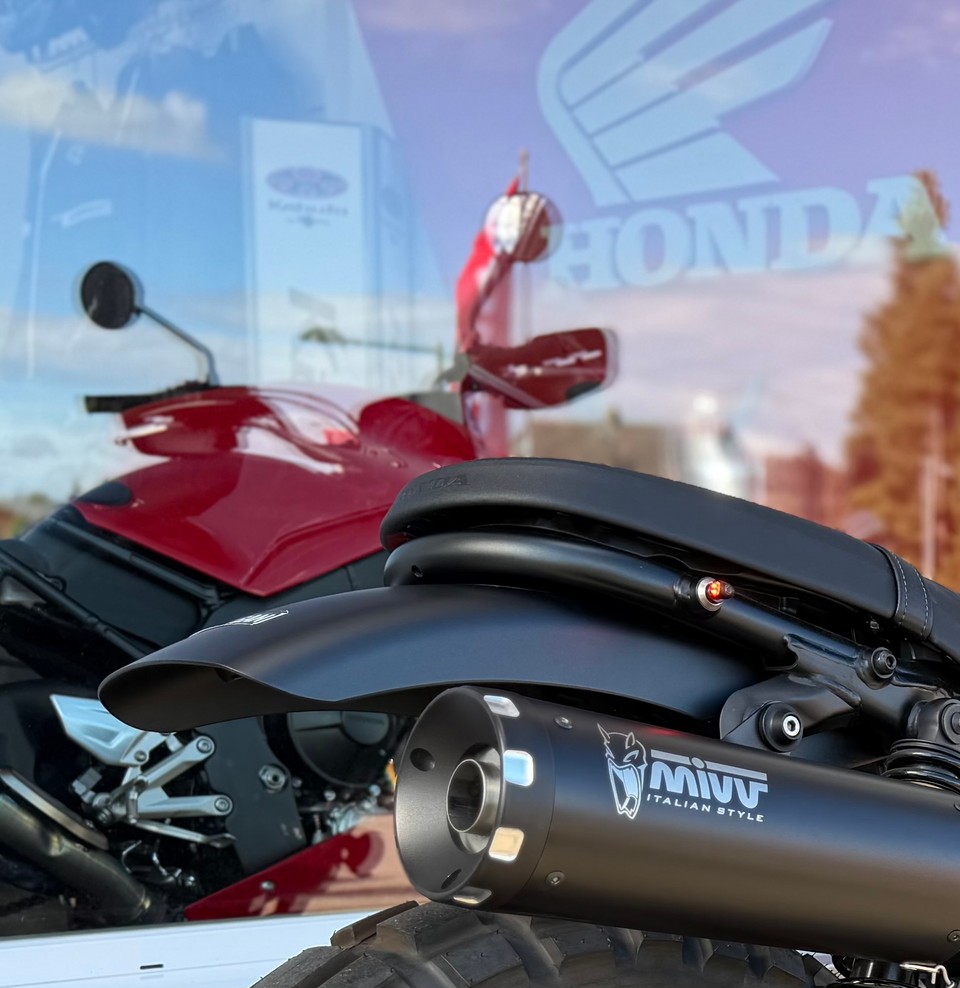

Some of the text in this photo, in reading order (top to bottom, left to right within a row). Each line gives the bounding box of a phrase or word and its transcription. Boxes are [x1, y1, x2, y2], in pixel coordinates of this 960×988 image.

[548, 175, 951, 291] HONDA
[647, 793, 765, 823] ITALIAN STYLE
